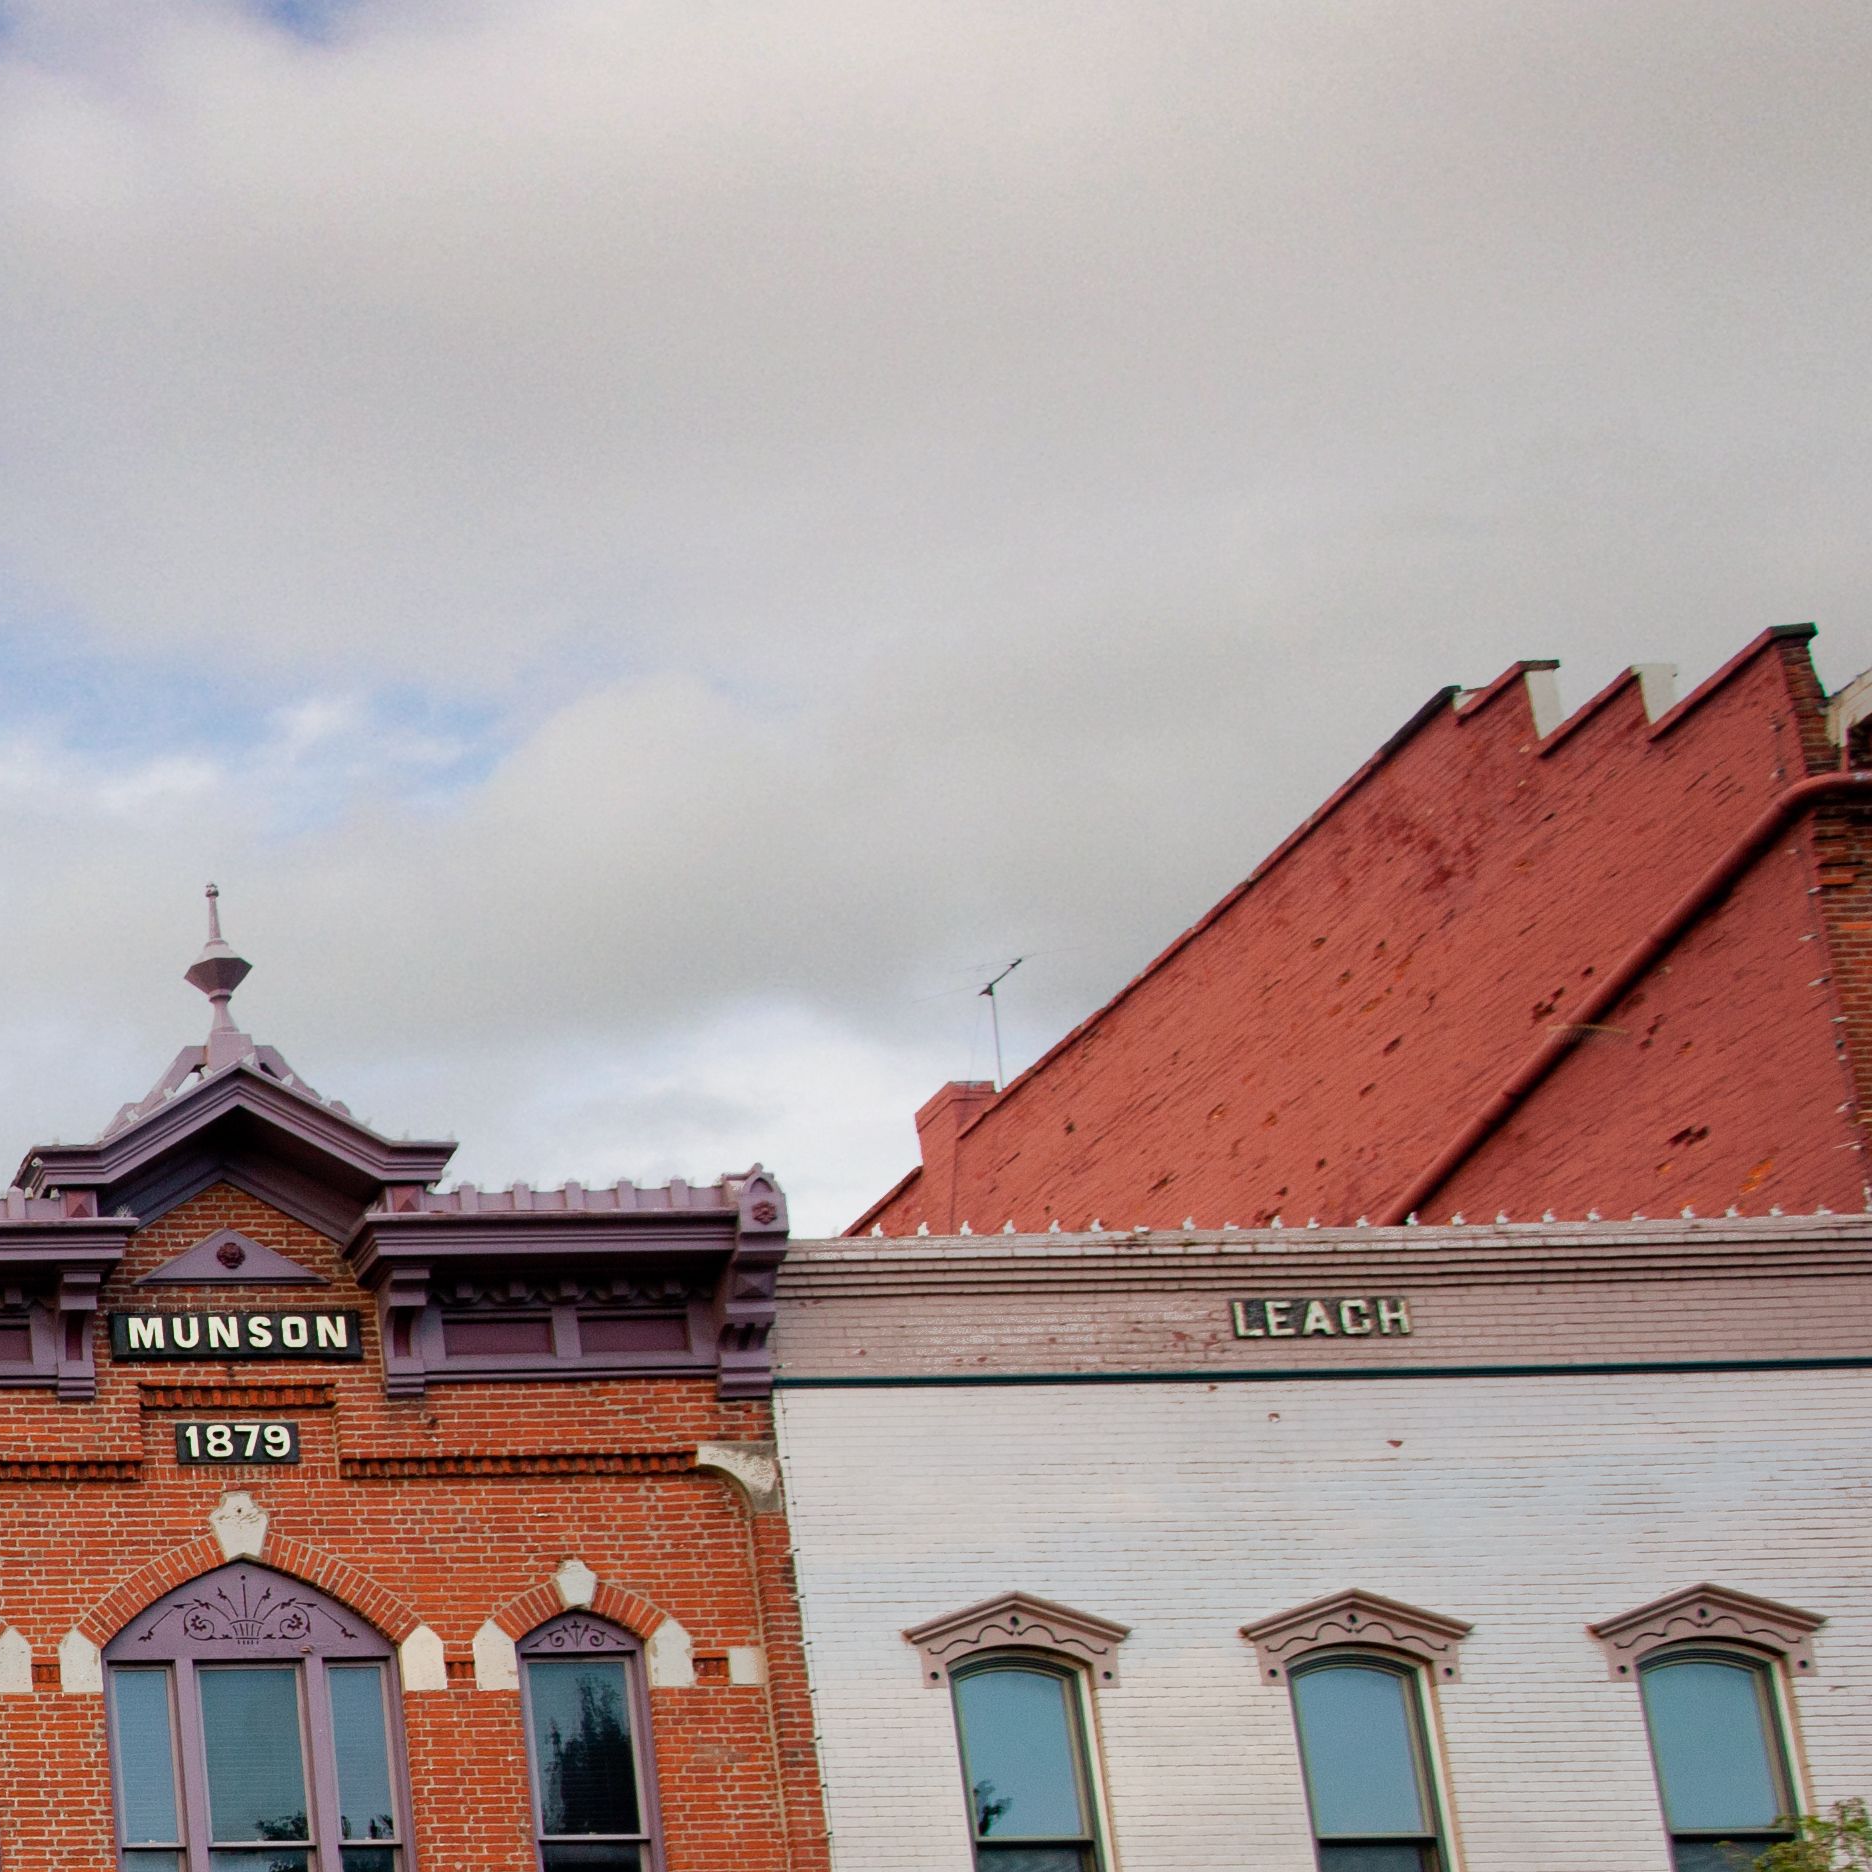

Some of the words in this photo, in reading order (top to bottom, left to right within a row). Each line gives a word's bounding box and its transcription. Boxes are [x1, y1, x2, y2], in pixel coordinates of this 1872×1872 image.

[128, 1316, 347, 1348] MUNSON
[1232, 1299, 1412, 1337] LEACH
[185, 1424, 291, 1458] 1879
